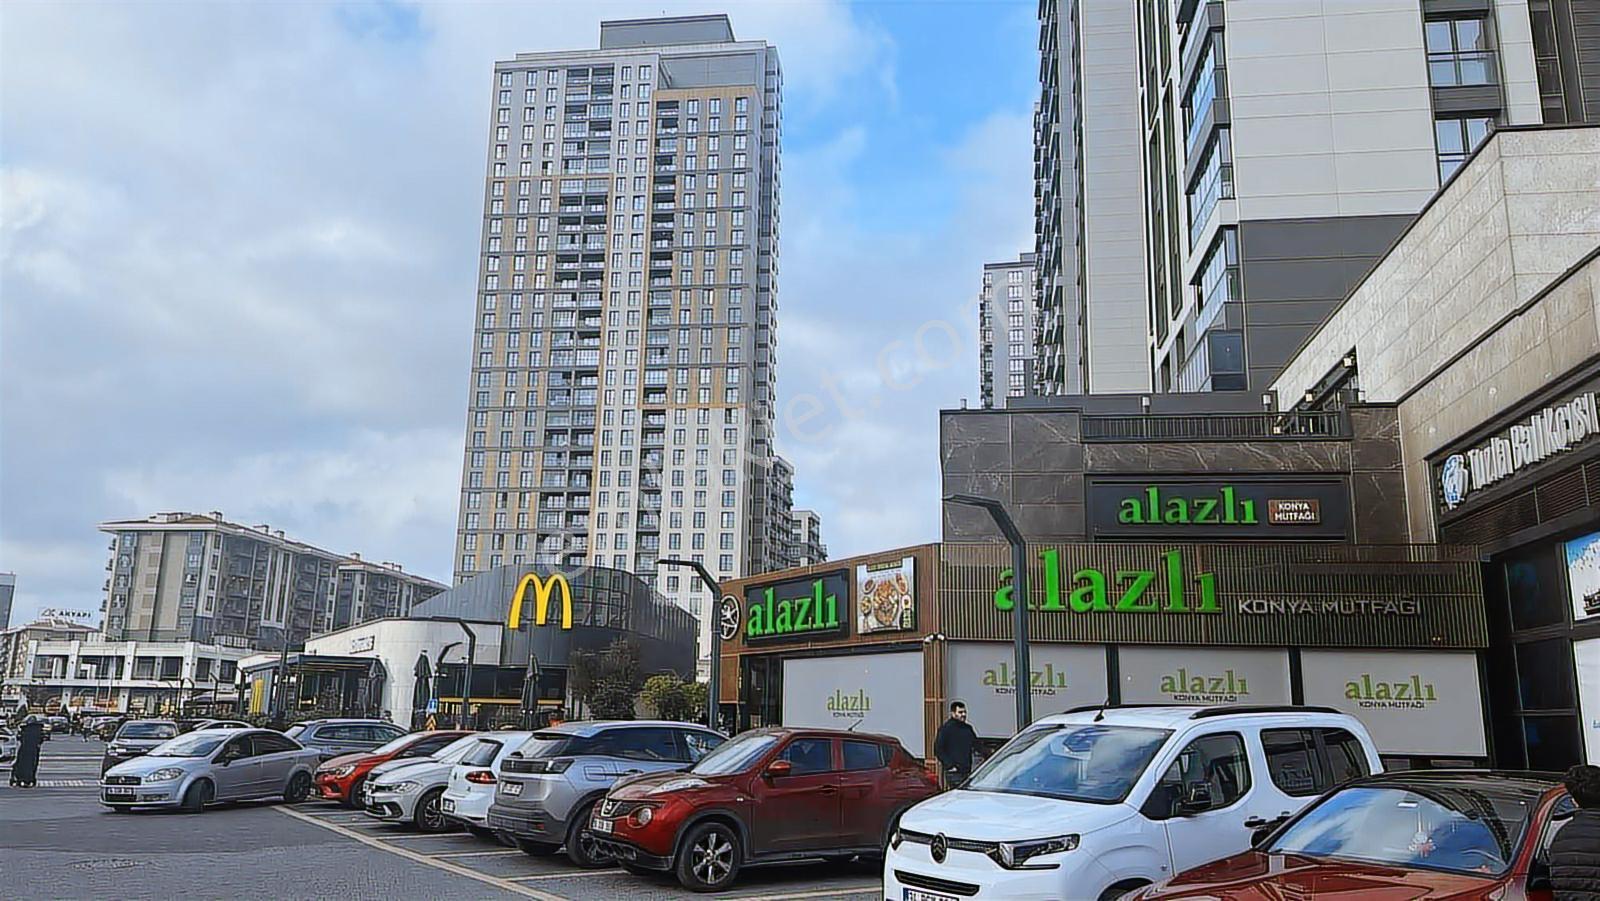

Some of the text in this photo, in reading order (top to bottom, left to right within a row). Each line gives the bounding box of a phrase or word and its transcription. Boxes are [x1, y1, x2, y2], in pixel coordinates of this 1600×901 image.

[1467, 437, 1515, 490] Tuzla
[1119, 485, 1258, 524] alazlı
[1279, 503, 1310, 511] KONYA
[994, 548, 1222, 613] alazlı
[747, 578, 839, 637] alazlı
[1238, 599, 1315, 614] KONYA
[995, 687, 1018, 695] KONY
[1160, 667, 1249, 695] alazlı
[1344, 674, 1437, 701] alazlı
[827, 689, 871, 711] alazlı
